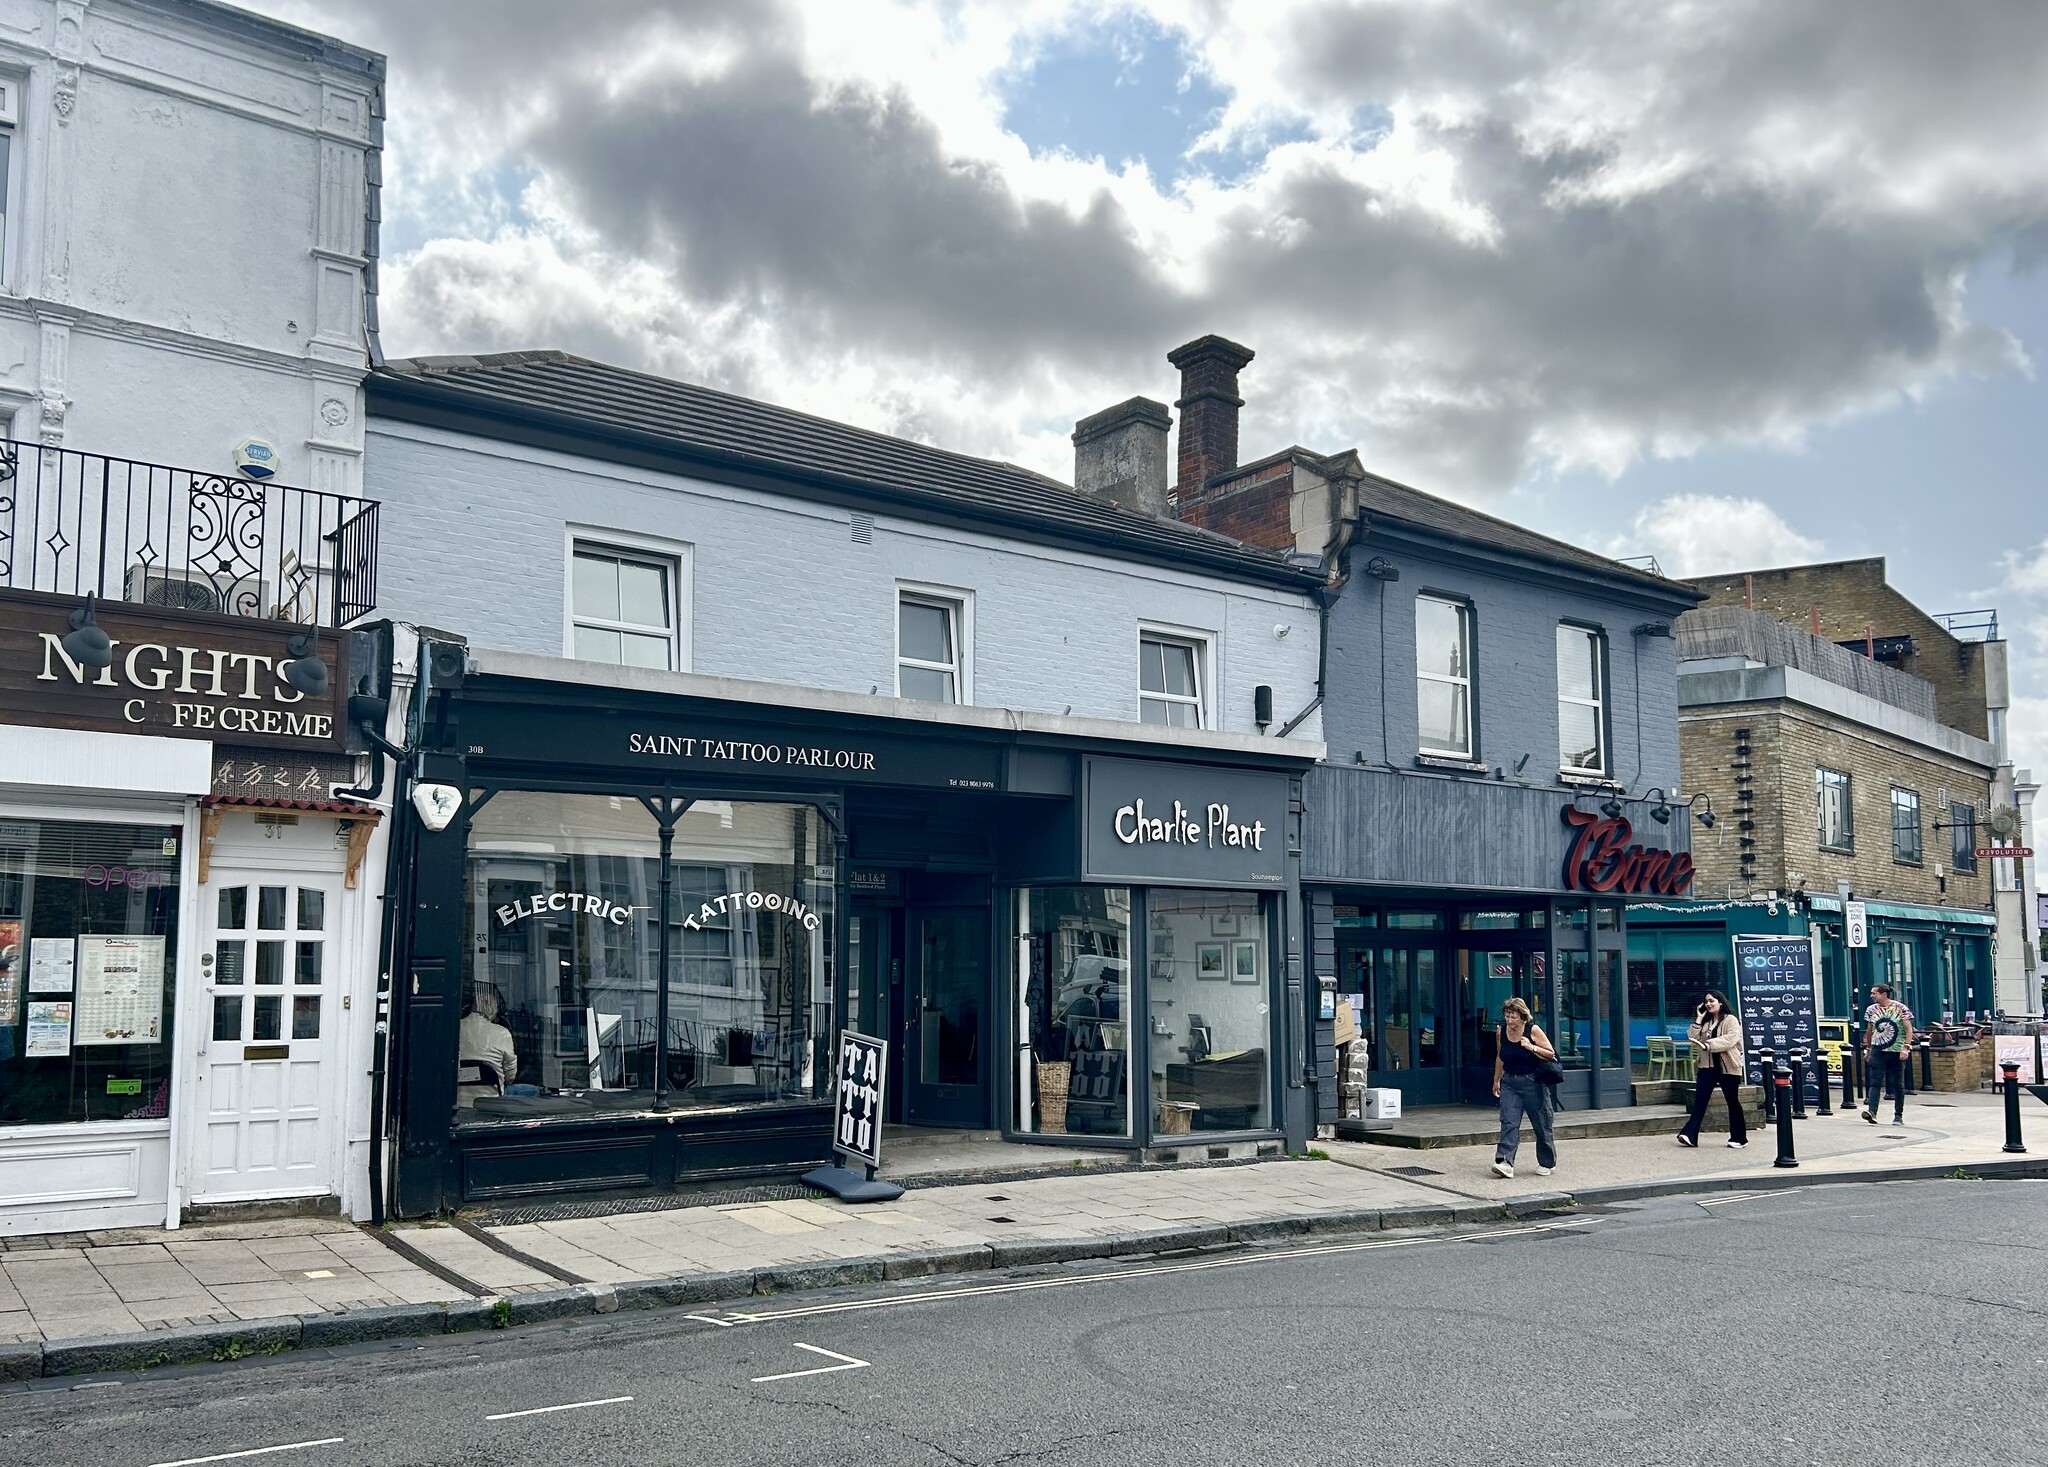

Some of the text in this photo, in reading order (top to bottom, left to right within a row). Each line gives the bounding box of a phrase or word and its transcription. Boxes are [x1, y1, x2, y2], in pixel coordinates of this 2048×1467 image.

[37, 633, 305, 703] NIGHTS
[124, 699, 145, 723] C
[467, 744, 484, 754] 30B
[629, 733, 876, 770] SAINT TATTOO PARLOUR
[264, 824, 282, 839] 31
[1115, 798, 1267, 851] Charlie Plant
[1251, 872, 1284, 882] Southampton
[496, 891, 632, 926] ELECTRIC
[683, 890, 821, 931] TATTOOING
[1738, 945, 1808, 954] LIGHT UP YOUR
[1744, 955, 1804, 968] SOCIAL
[1755, 971, 1795, 982] LIFE
